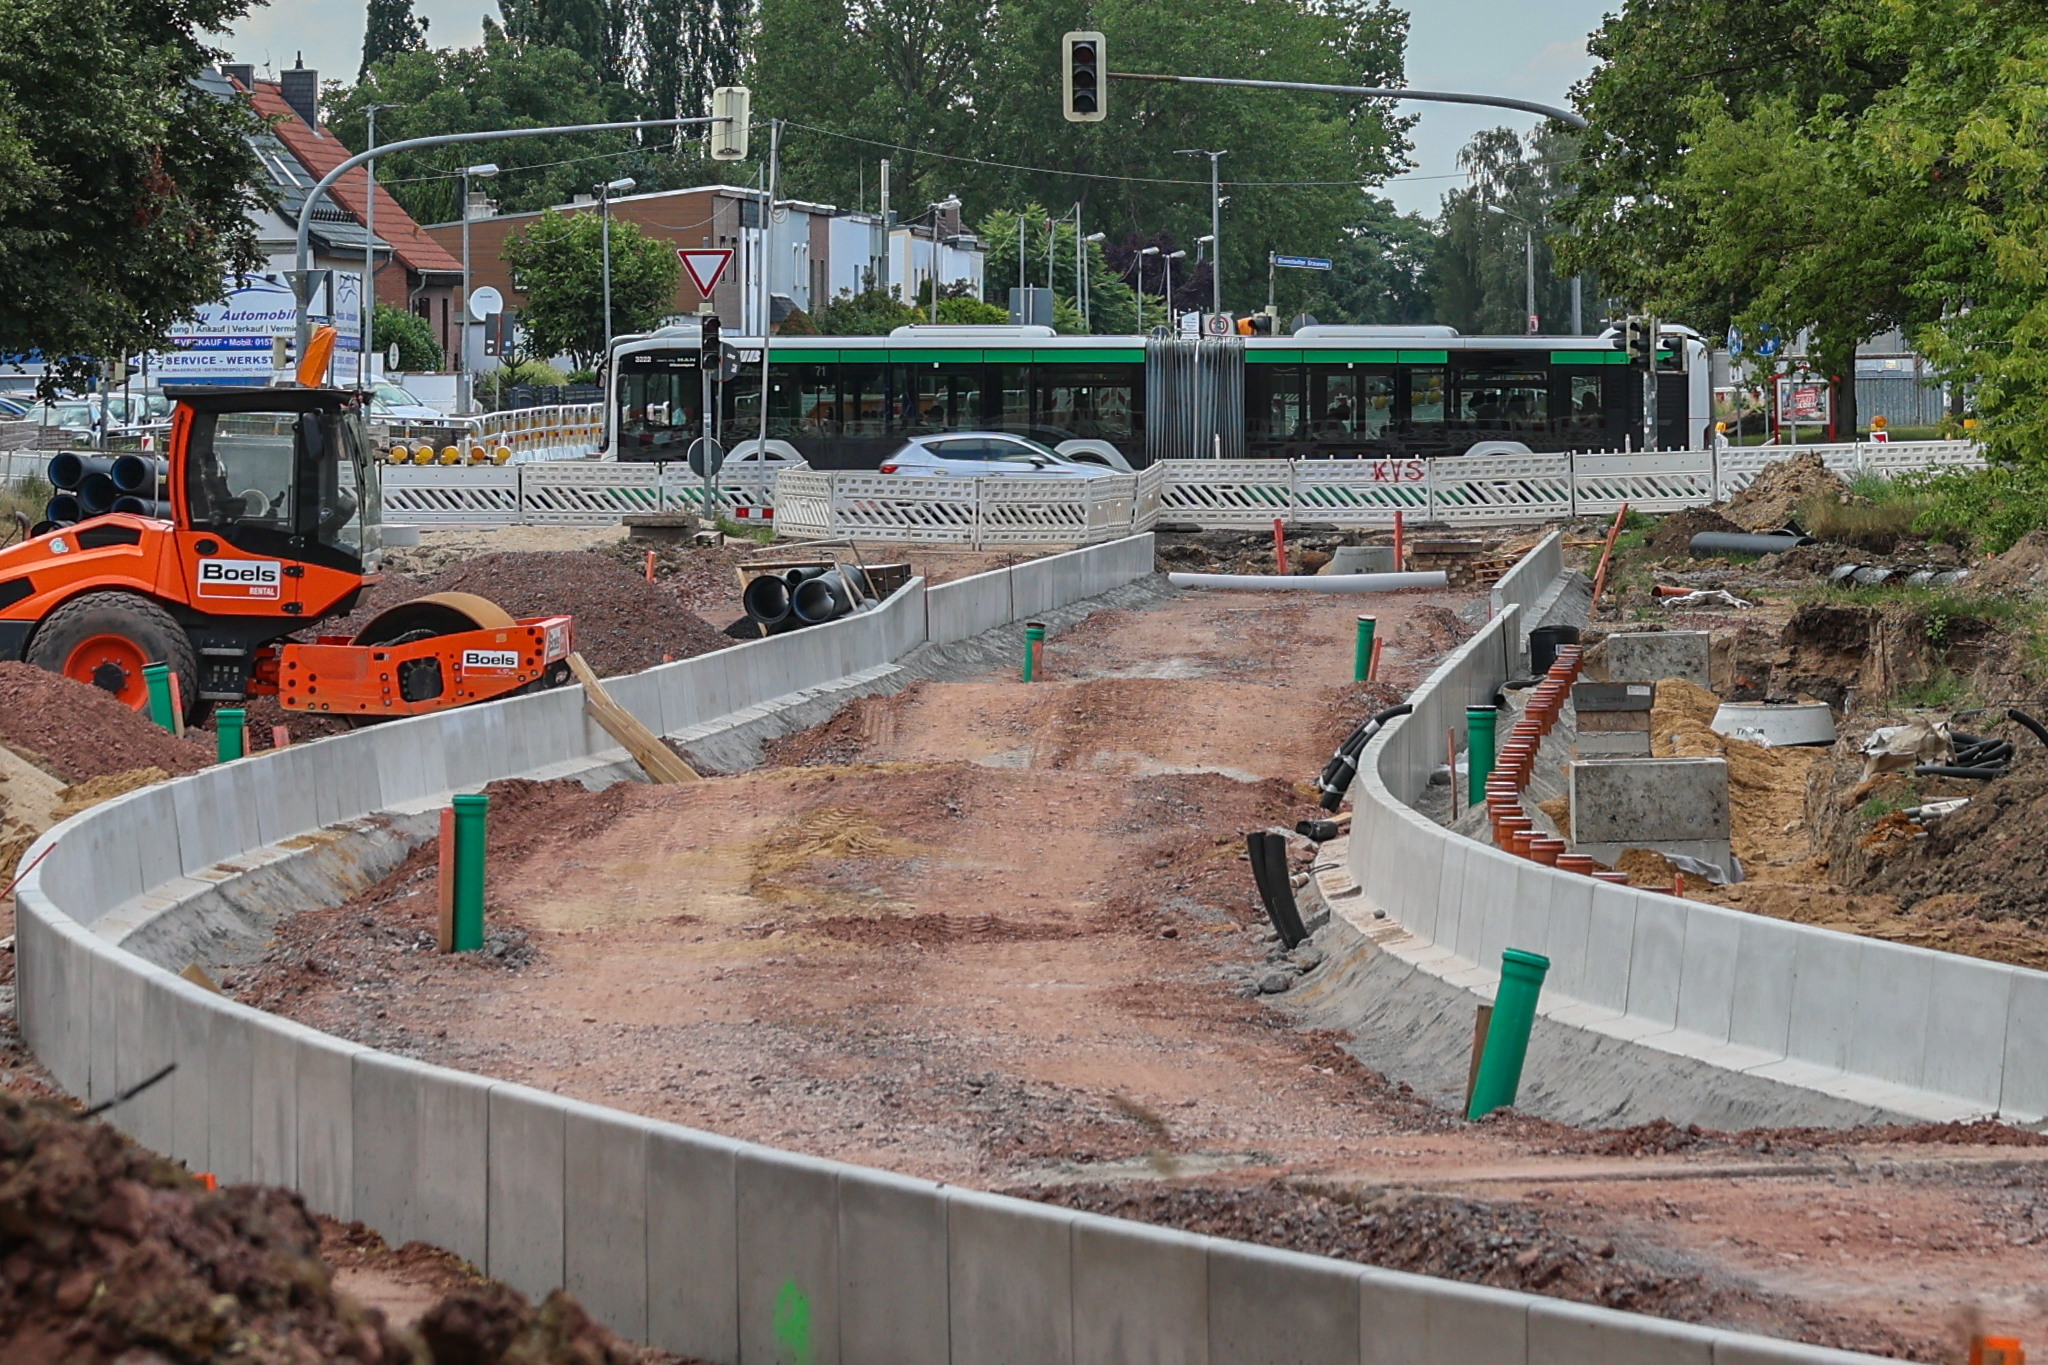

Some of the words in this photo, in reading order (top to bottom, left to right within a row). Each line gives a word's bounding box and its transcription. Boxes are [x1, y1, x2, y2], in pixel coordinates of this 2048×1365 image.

[219, 309, 297, 321] Automobil
[232, 325, 264, 333] Verkauf
[165, 356, 217, 366] SERVICE
[226, 356, 275, 365] WERKST
[203, 563, 276, 582] Boels
[249, 587, 275, 596] RENTAL
[466, 653, 515, 665] Boels
